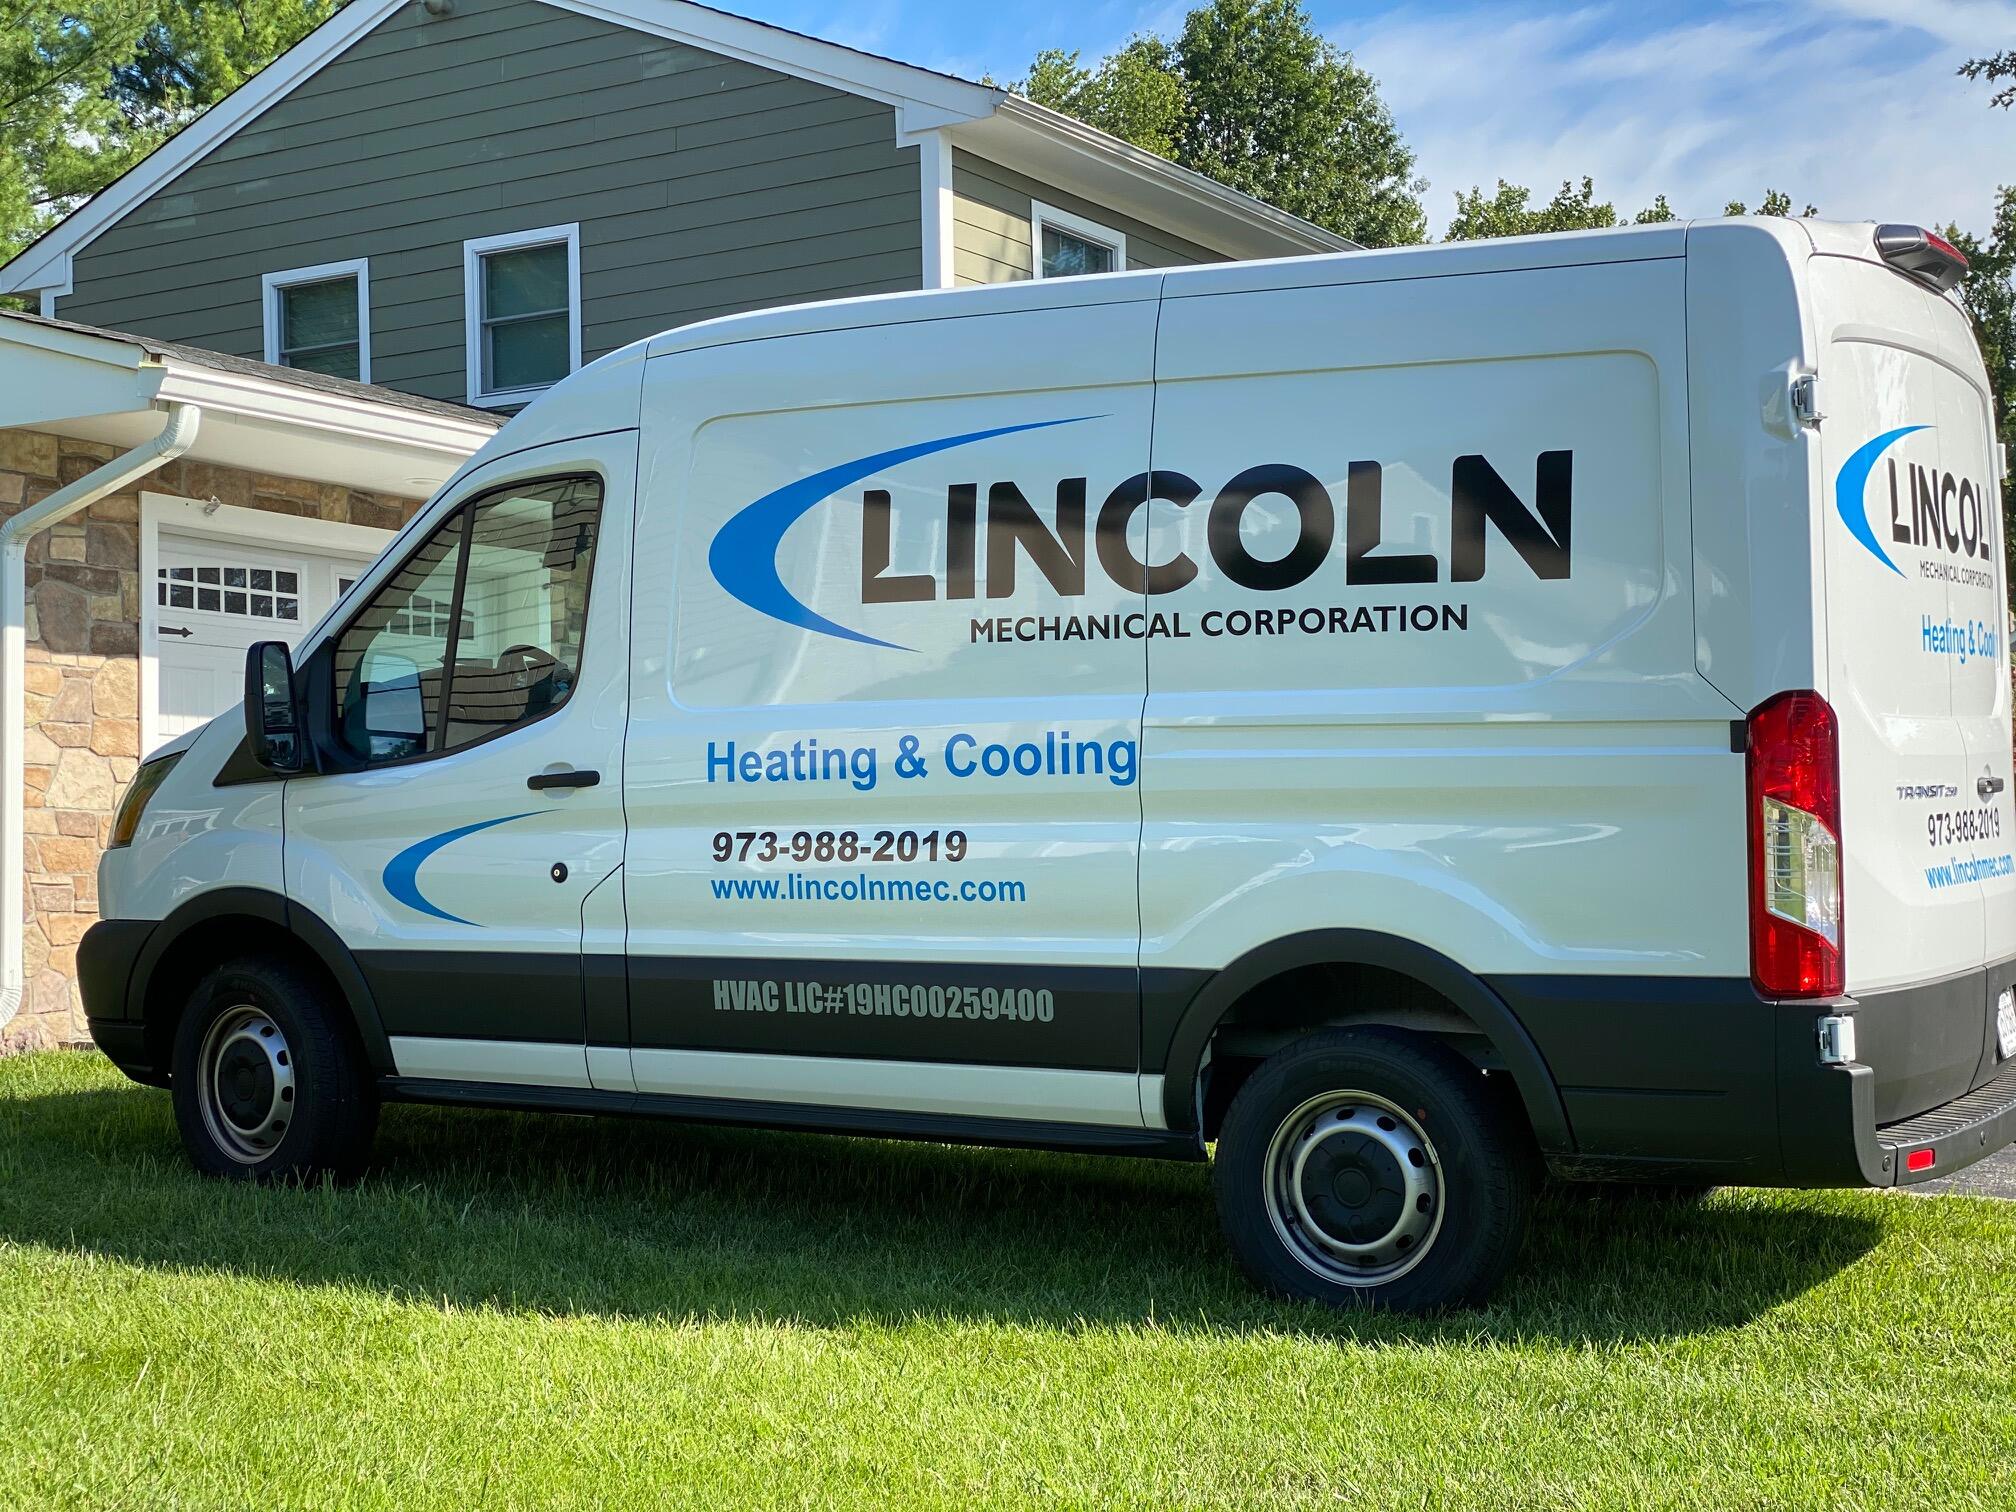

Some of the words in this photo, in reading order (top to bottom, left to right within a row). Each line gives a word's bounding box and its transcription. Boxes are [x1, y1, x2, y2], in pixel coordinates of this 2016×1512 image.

[862, 449, 1573, 605] LINCOLN
[1887, 456, 1993, 563] LINCOL
[1920, 560, 1960, 583] MECHANICAL
[970, 611, 1191, 643] MECHANICAL
[1200, 604, 1468, 637] CORPORATION
[1922, 614, 1966, 664] Heating
[1968, 619, 1976, 656] &
[707, 738, 877, 791] Heating
[894, 734, 928, 779] &
[944, 731, 1138, 786] Cooling
[1896, 785, 1945, 800] TRANSIT
[711, 830, 968, 863] 973-988-2019
[1928, 807, 2000, 847] 973-988-2019
[710, 873, 1026, 902] www.lincolnmec.com
[1924, 853, 2015, 890] www.lincolnmec.com
[713, 980, 780, 1013] HVAC
[784, 981, 1055, 1023] LIC#19HC00259400
